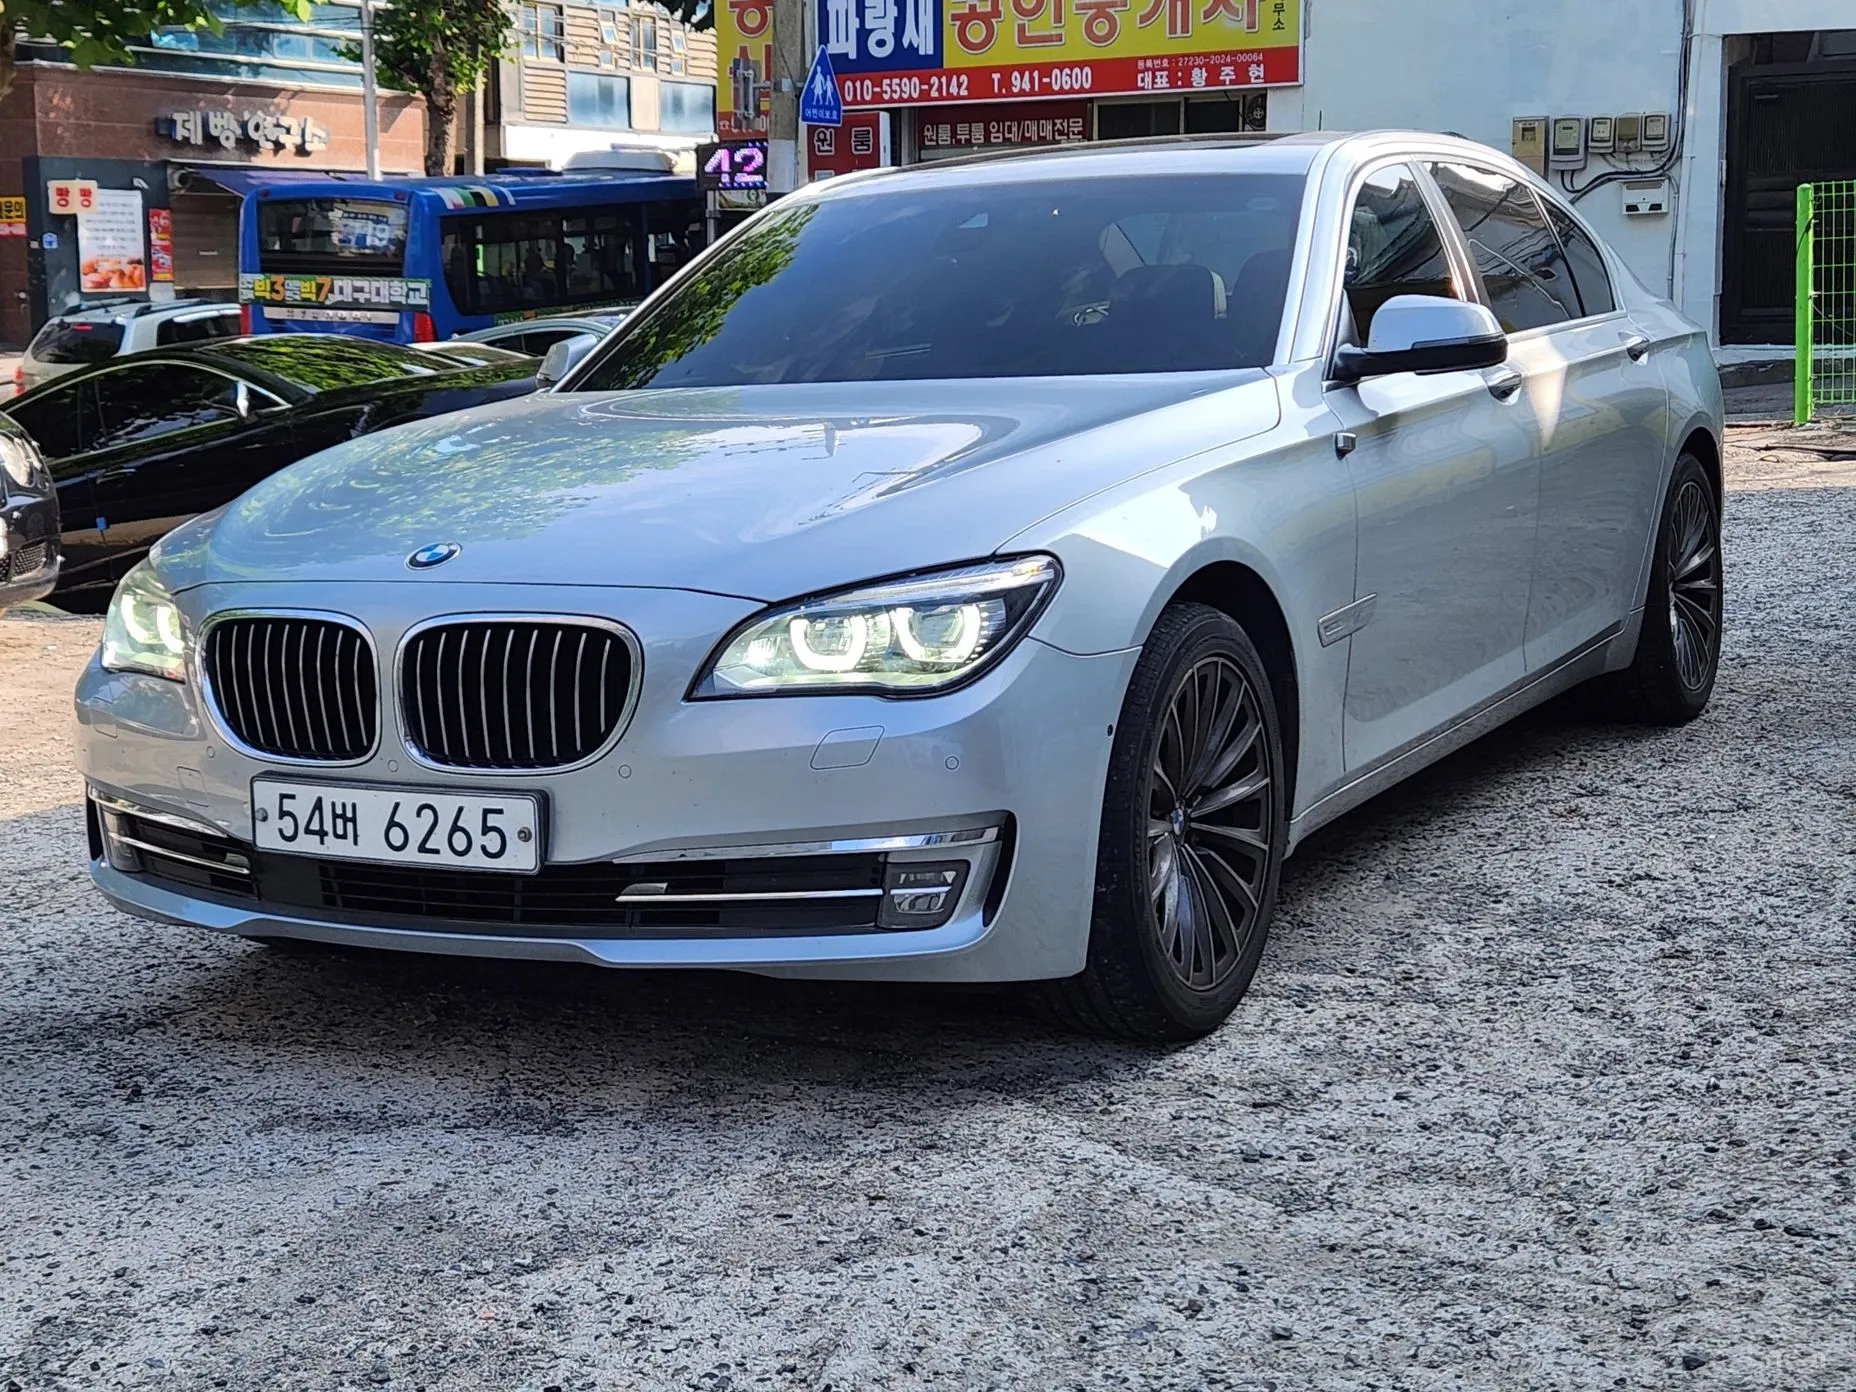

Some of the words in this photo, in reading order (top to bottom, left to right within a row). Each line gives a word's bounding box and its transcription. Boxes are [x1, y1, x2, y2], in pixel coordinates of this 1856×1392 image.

[826, 0, 934, 60] 파랑새
[1272, 0, 1286, 31] 무소
[1178, 53, 1264, 66] 27230-2024-00064
[844, 74, 969, 102] 010-5590-2142
[1136, 70, 1170, 90] 대표
[703, 147, 766, 184] 42
[334, 280, 428, 305] 대구대학교
[277, 792, 359, 846] 54버
[383, 801, 508, 859] 6265
